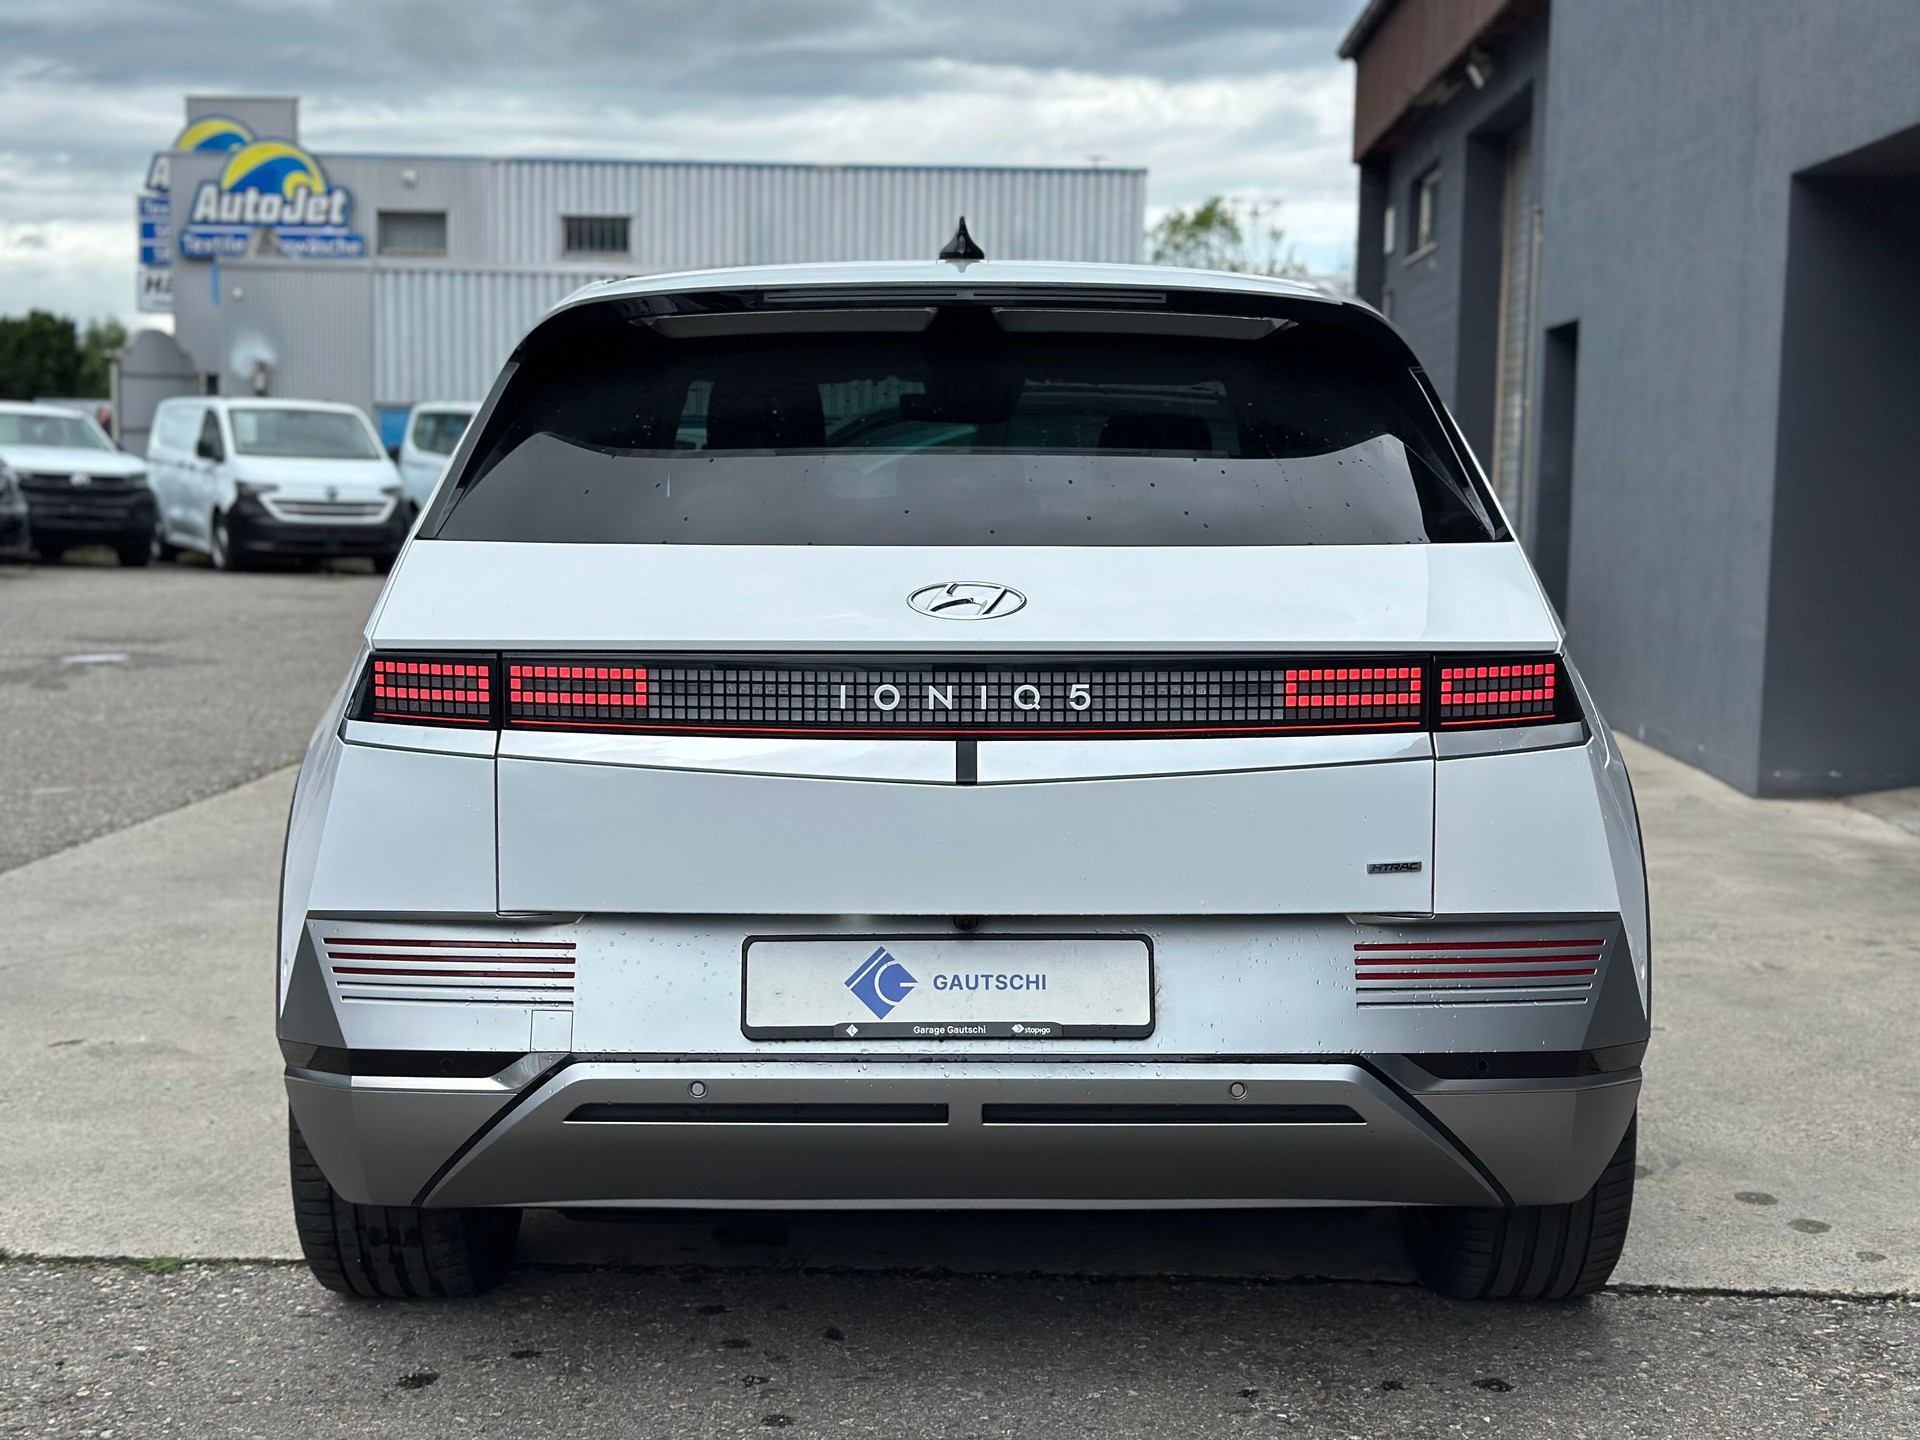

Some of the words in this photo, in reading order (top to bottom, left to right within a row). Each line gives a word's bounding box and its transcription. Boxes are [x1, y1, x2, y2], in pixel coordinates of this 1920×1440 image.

[193, 184, 346, 223] AutoJet
[840, 684, 1041, 711] IONIQ
[1371, 862, 1419, 872] HTRAC
[932, 973, 1047, 992] GAUTSCHI
[913, 1025, 945, 1036] Garage
[947, 1025, 987, 1034] Gautschi
